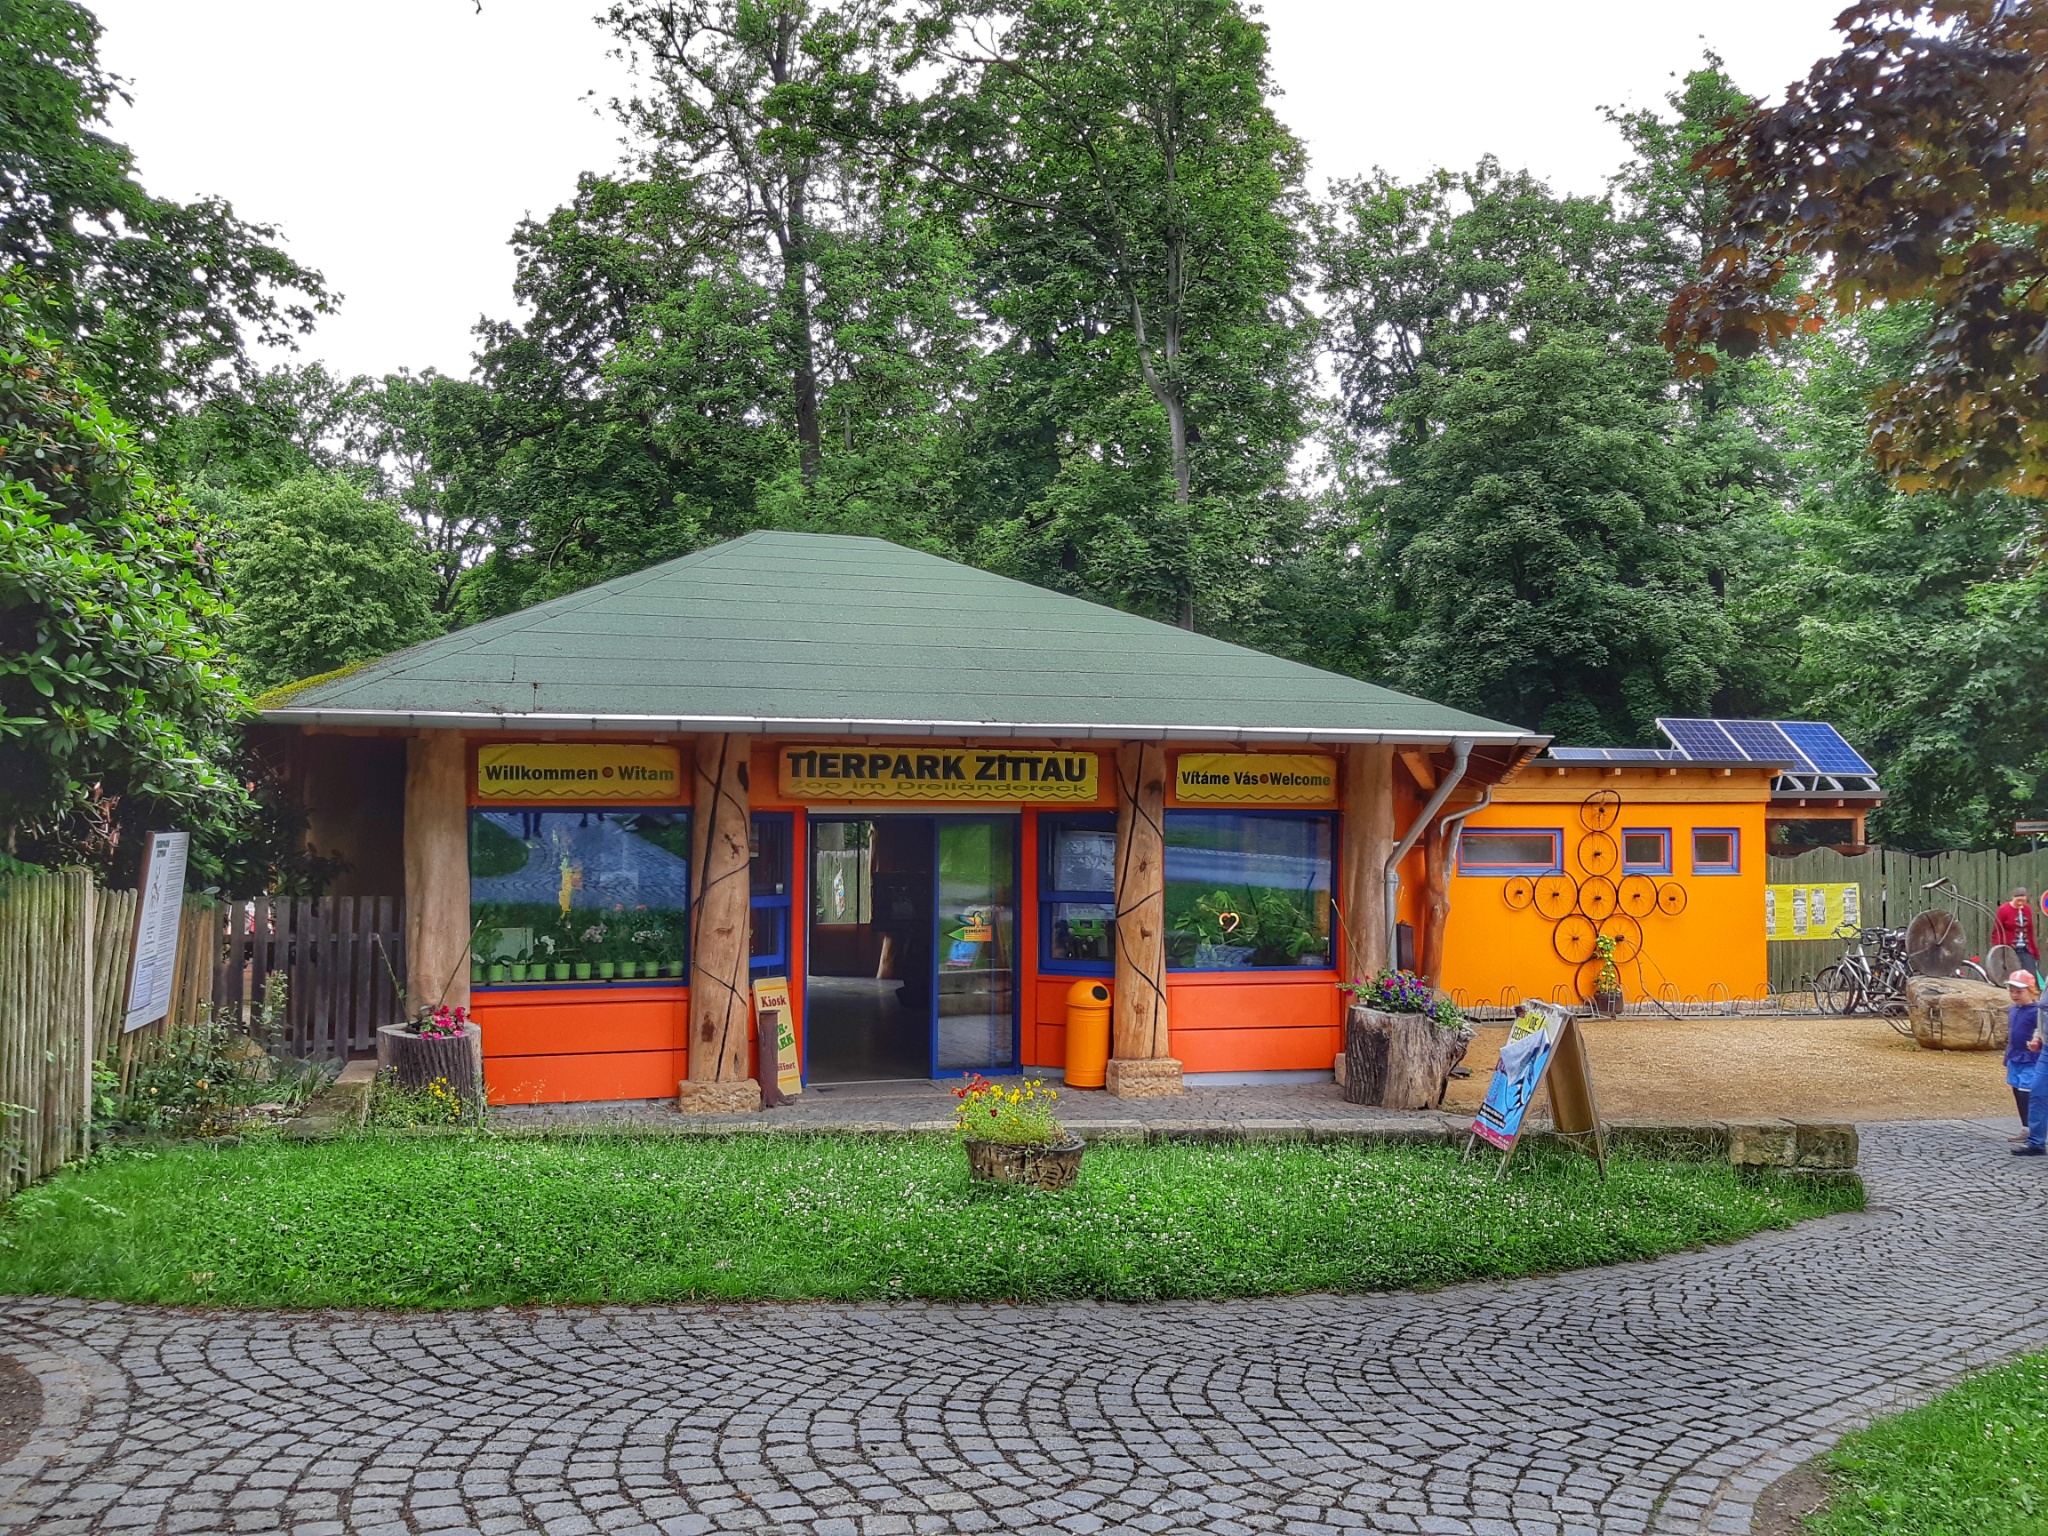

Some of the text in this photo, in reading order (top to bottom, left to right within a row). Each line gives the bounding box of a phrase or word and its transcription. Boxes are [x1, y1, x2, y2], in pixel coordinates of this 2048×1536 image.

[485, 765, 675, 781] Willkommen Witam
[1182, 770, 1331, 786] Vítáme Vás Welcome
[790, 781, 1086, 793] Zoo im Dreiländereck
[761, 994, 787, 1007] Kiosk
